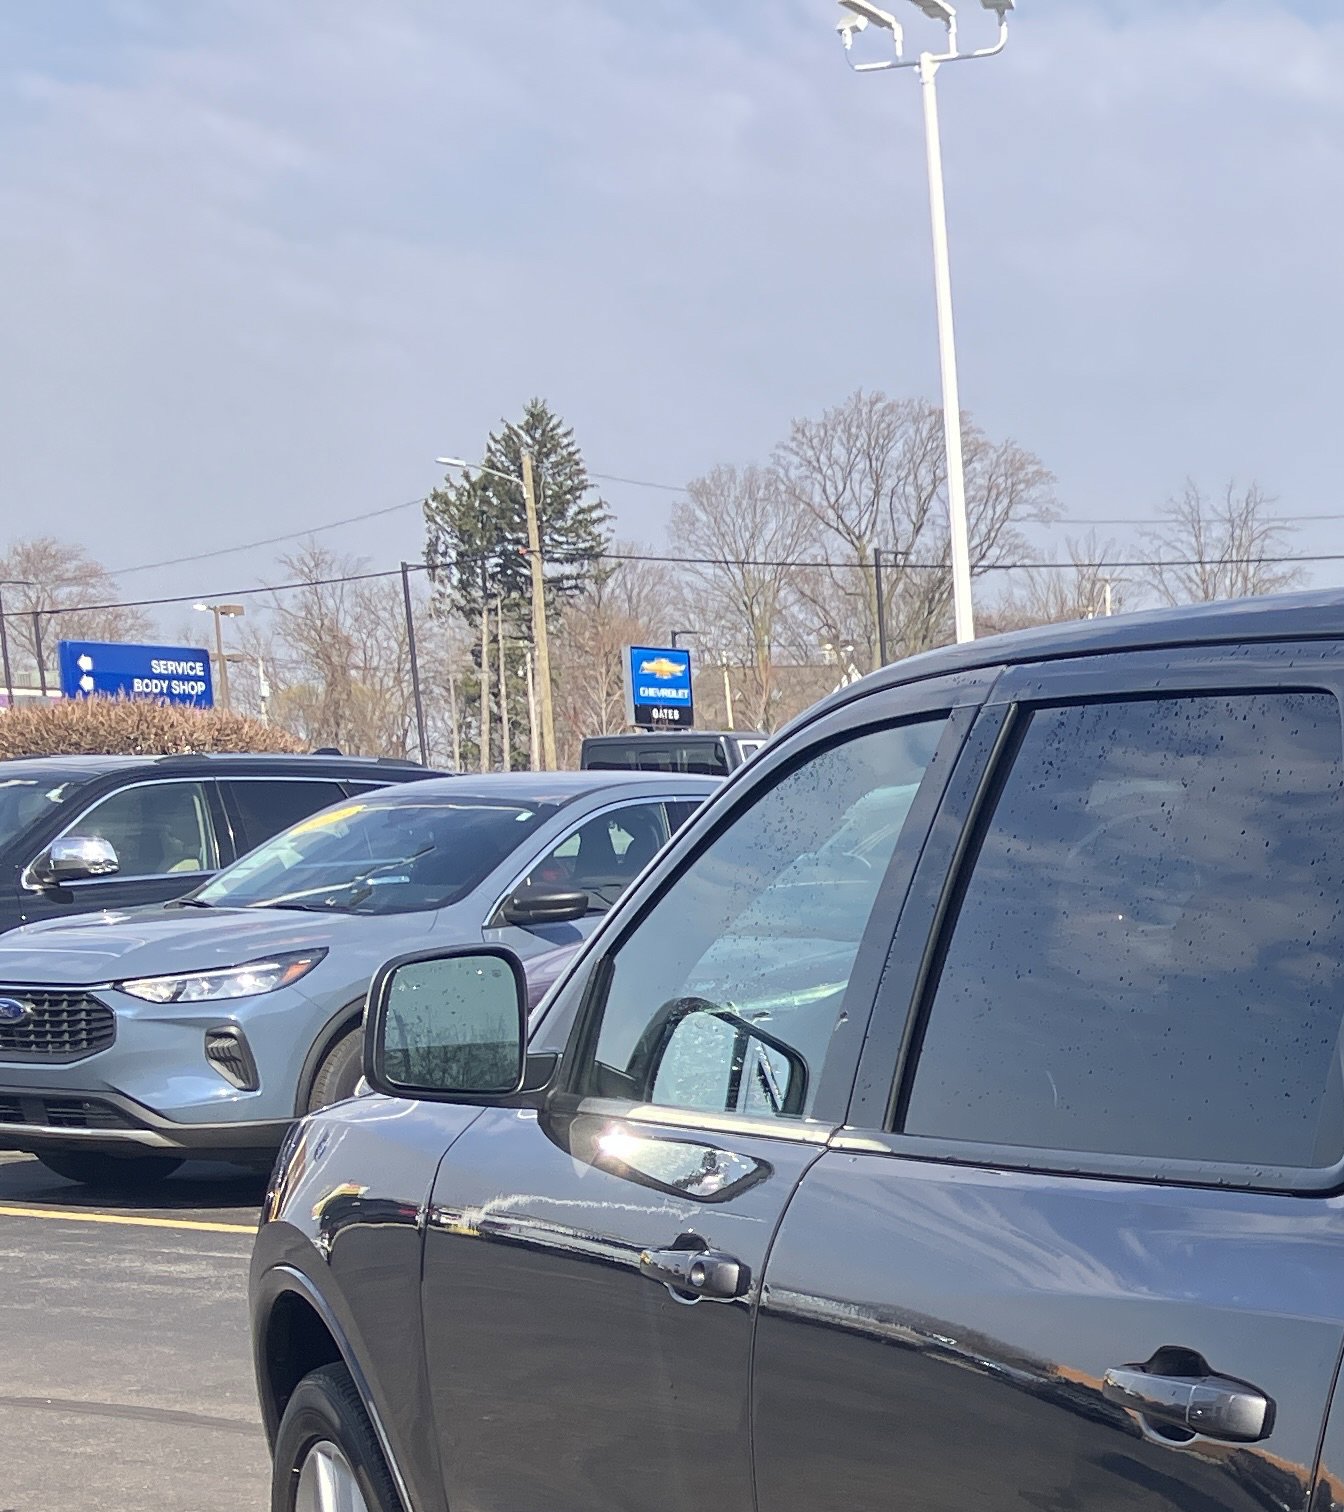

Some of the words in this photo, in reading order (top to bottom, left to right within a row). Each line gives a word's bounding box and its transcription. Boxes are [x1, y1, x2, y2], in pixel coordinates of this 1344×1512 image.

[151, 660, 205, 676] SERVICE
[133, 679, 169, 694] BODY
[171, 681, 206, 695] SHOP
[640, 687, 688, 699] CHEVROLET
